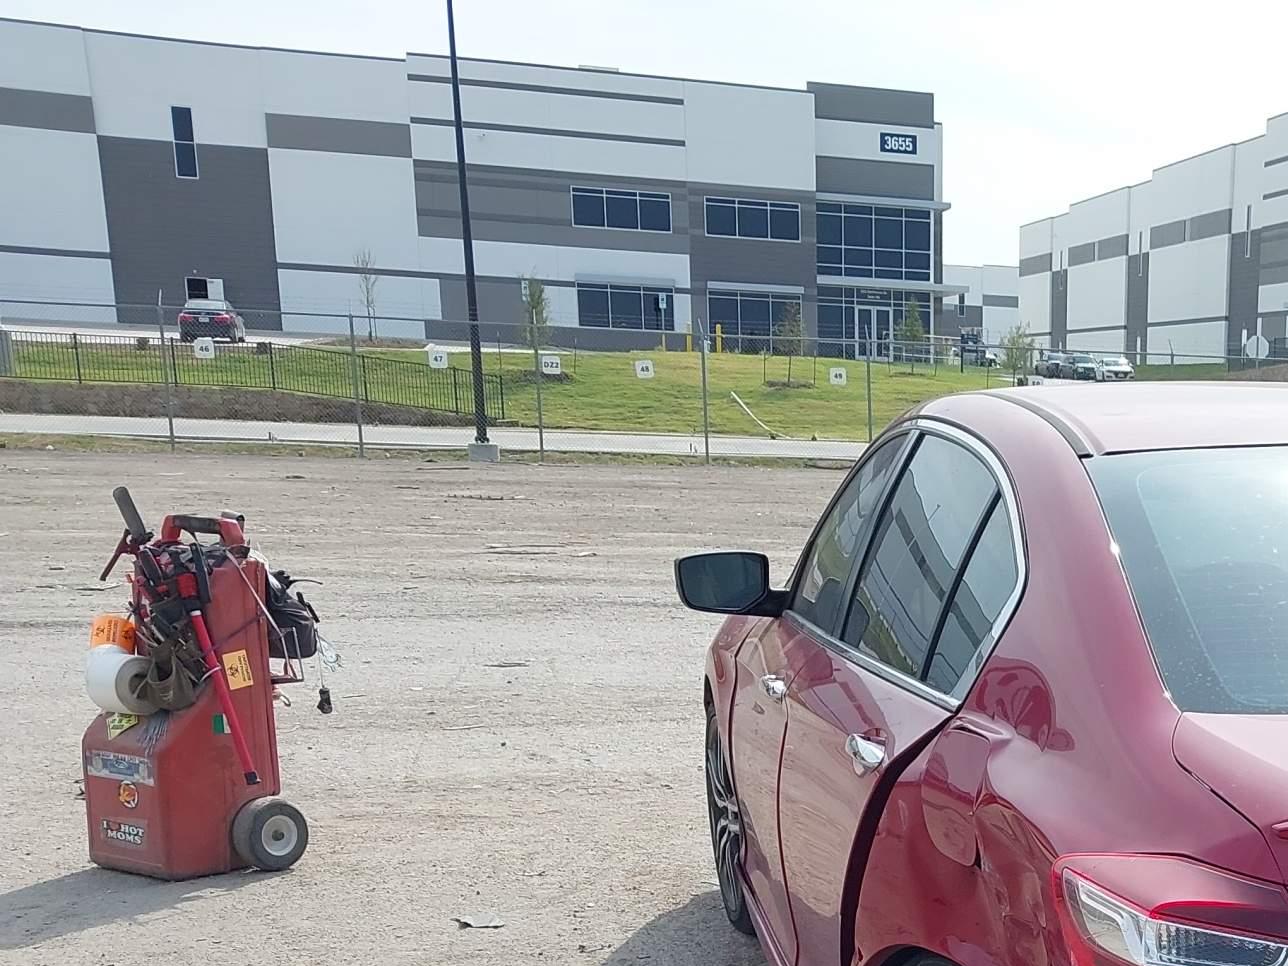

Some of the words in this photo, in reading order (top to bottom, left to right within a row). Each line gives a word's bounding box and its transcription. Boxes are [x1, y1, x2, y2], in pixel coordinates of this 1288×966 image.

[884, 135, 913, 151] 3655
[199, 345, 210, 353] 46
[107, 829, 142, 845] MOMS
[120, 823, 144, 837] HOT
